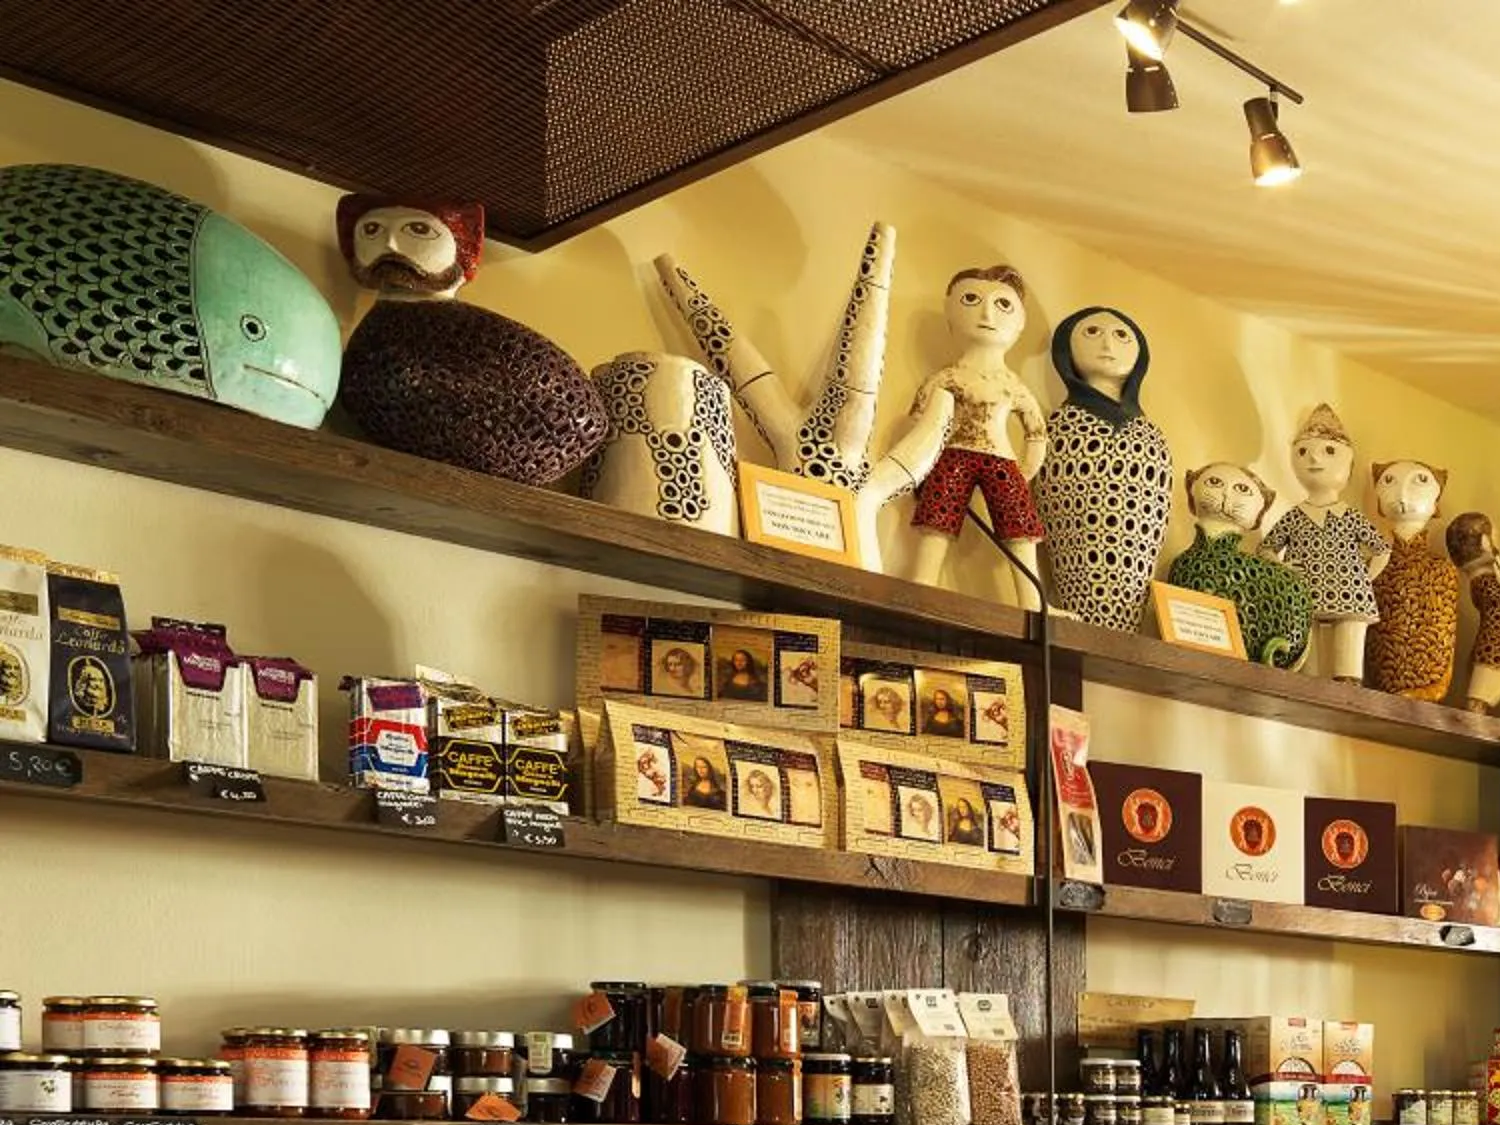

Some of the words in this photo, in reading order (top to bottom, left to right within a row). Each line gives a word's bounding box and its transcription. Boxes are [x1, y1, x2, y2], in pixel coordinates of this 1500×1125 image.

[1116, 847, 1181, 873] Bonci
[1225, 862, 1280, 885] Bonci
[1316, 875, 1374, 895] Bonci
